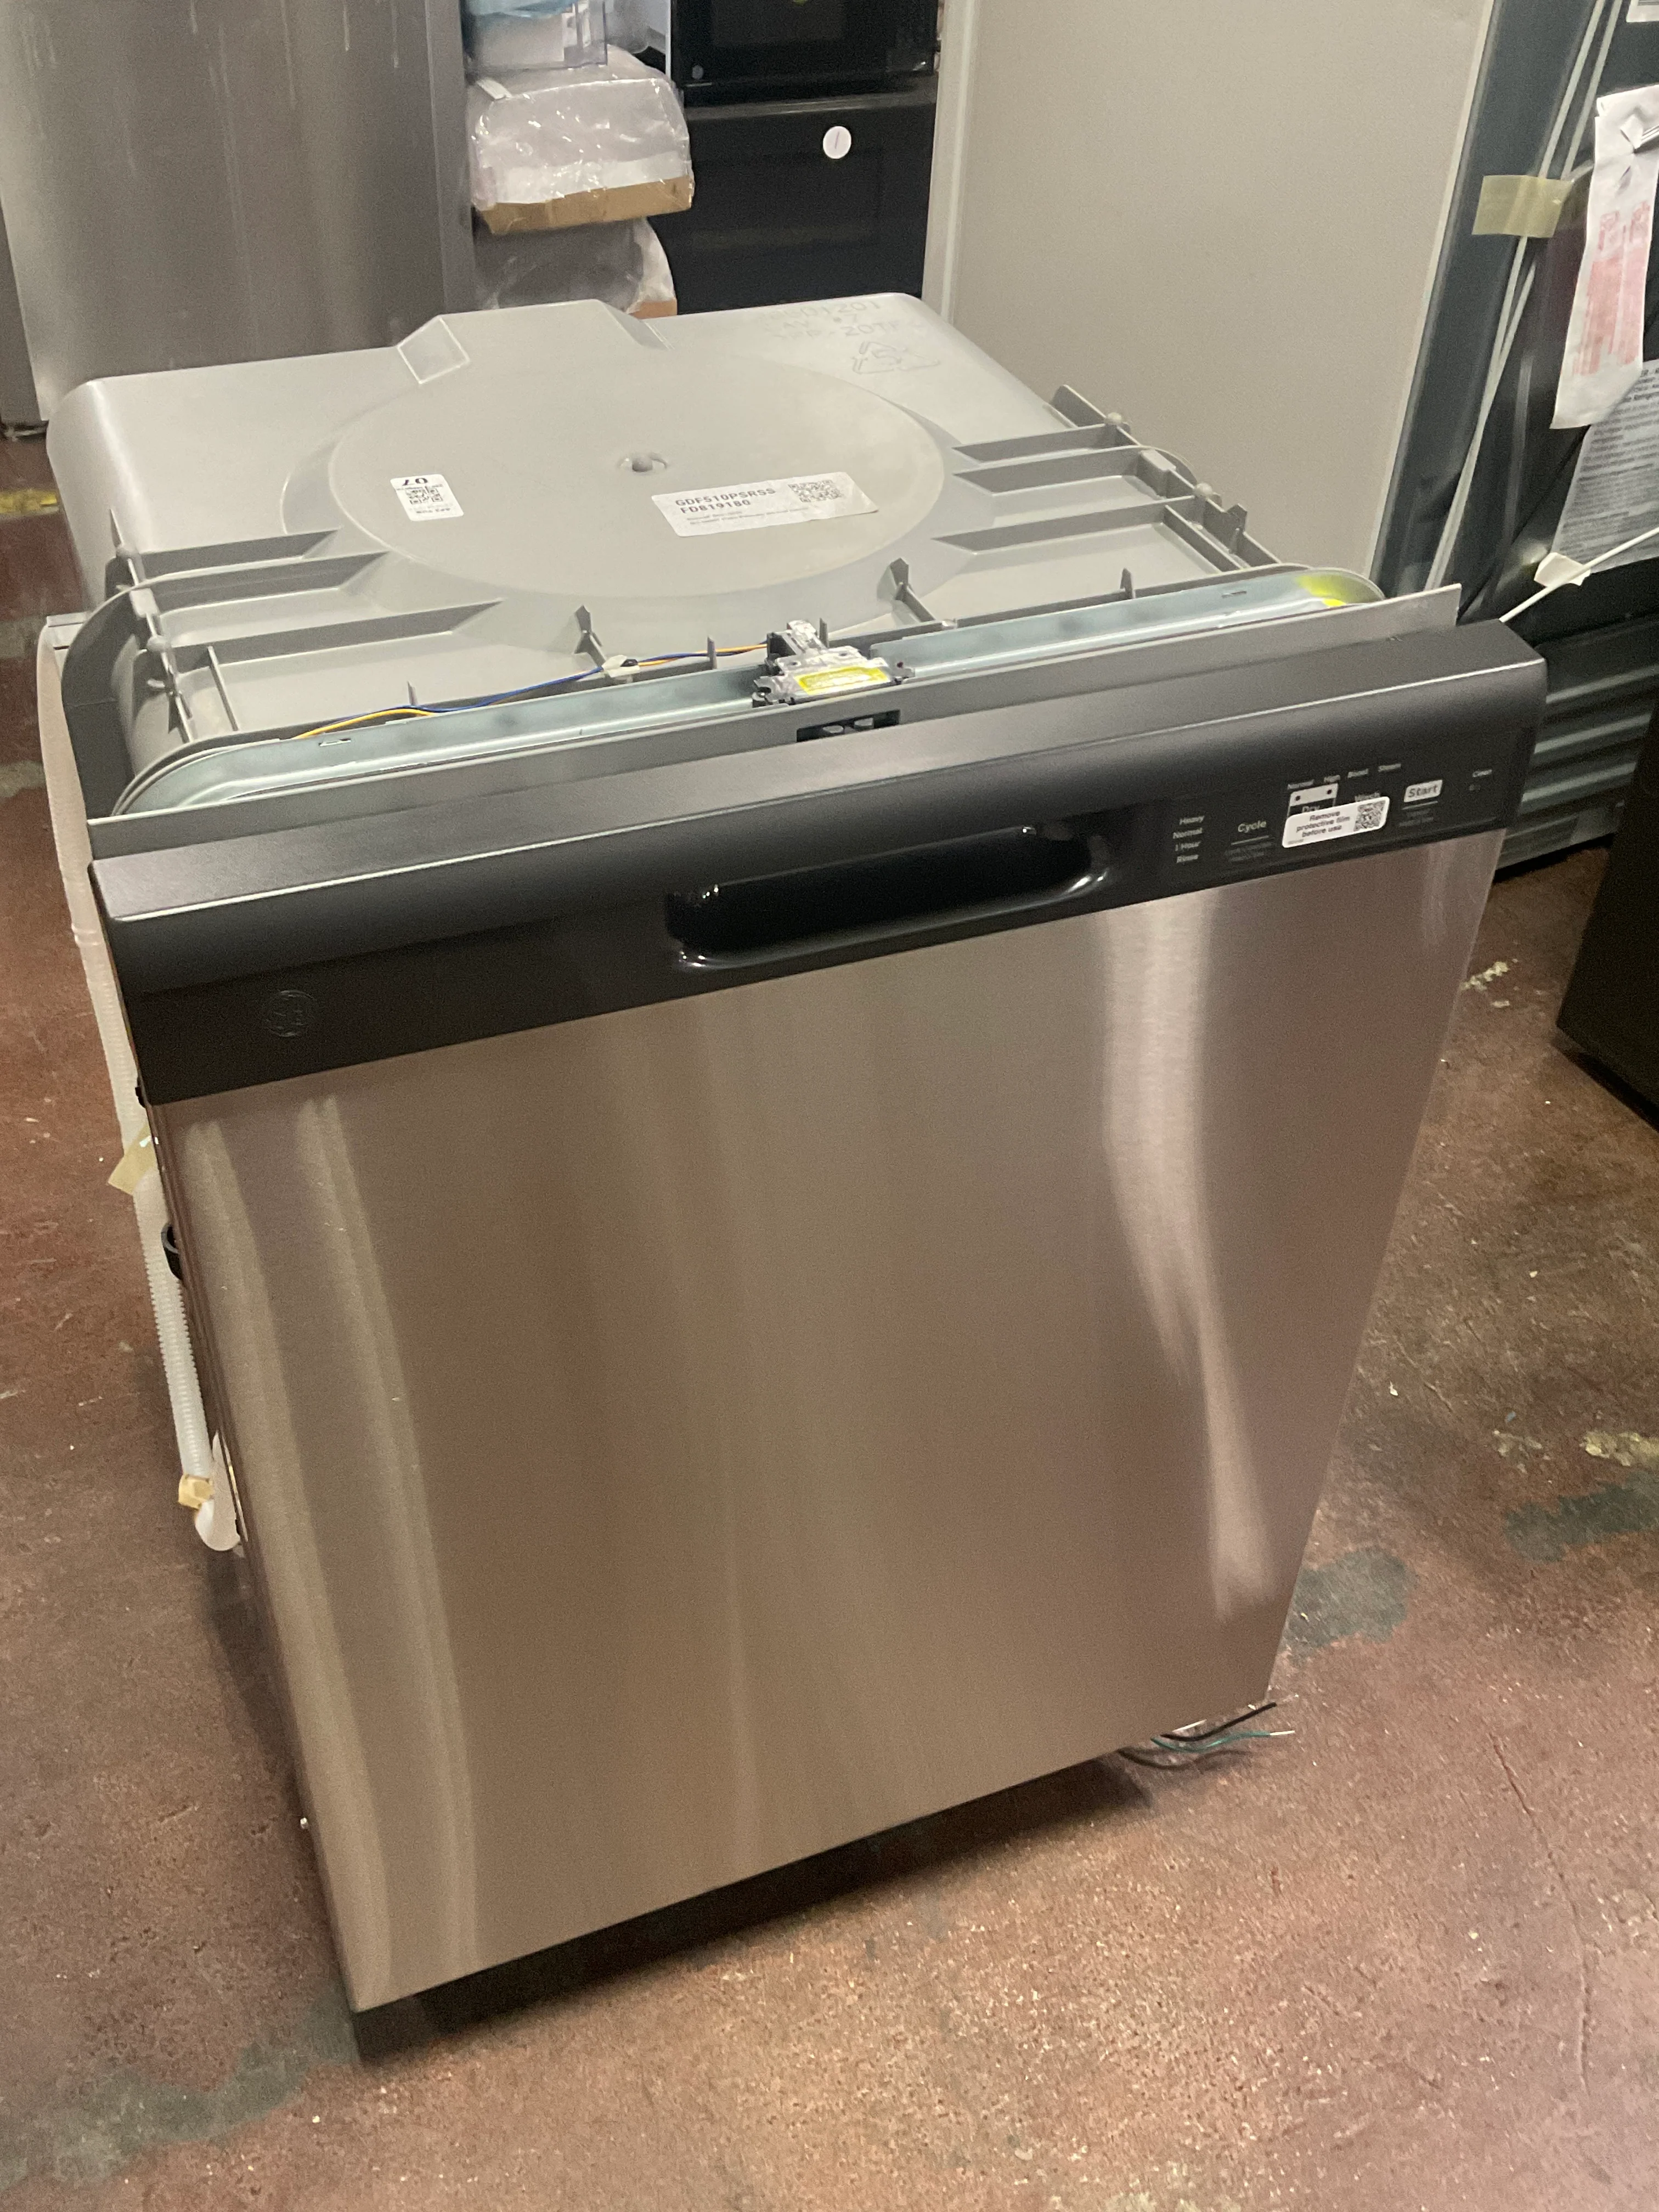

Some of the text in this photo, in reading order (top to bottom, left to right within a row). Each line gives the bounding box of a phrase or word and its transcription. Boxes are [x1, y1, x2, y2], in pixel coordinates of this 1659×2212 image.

[675, 488, 776, 506] GDF510PSRSS
[1408, 785, 1438, 798] Start
[1310, 811, 1340, 821] Remove
[1173, 827, 1203, 839] Normal
[1238, 820, 1267, 833] Cycle
[1296, 820, 1334, 833] protective
[1302, 828, 1326, 837] before
